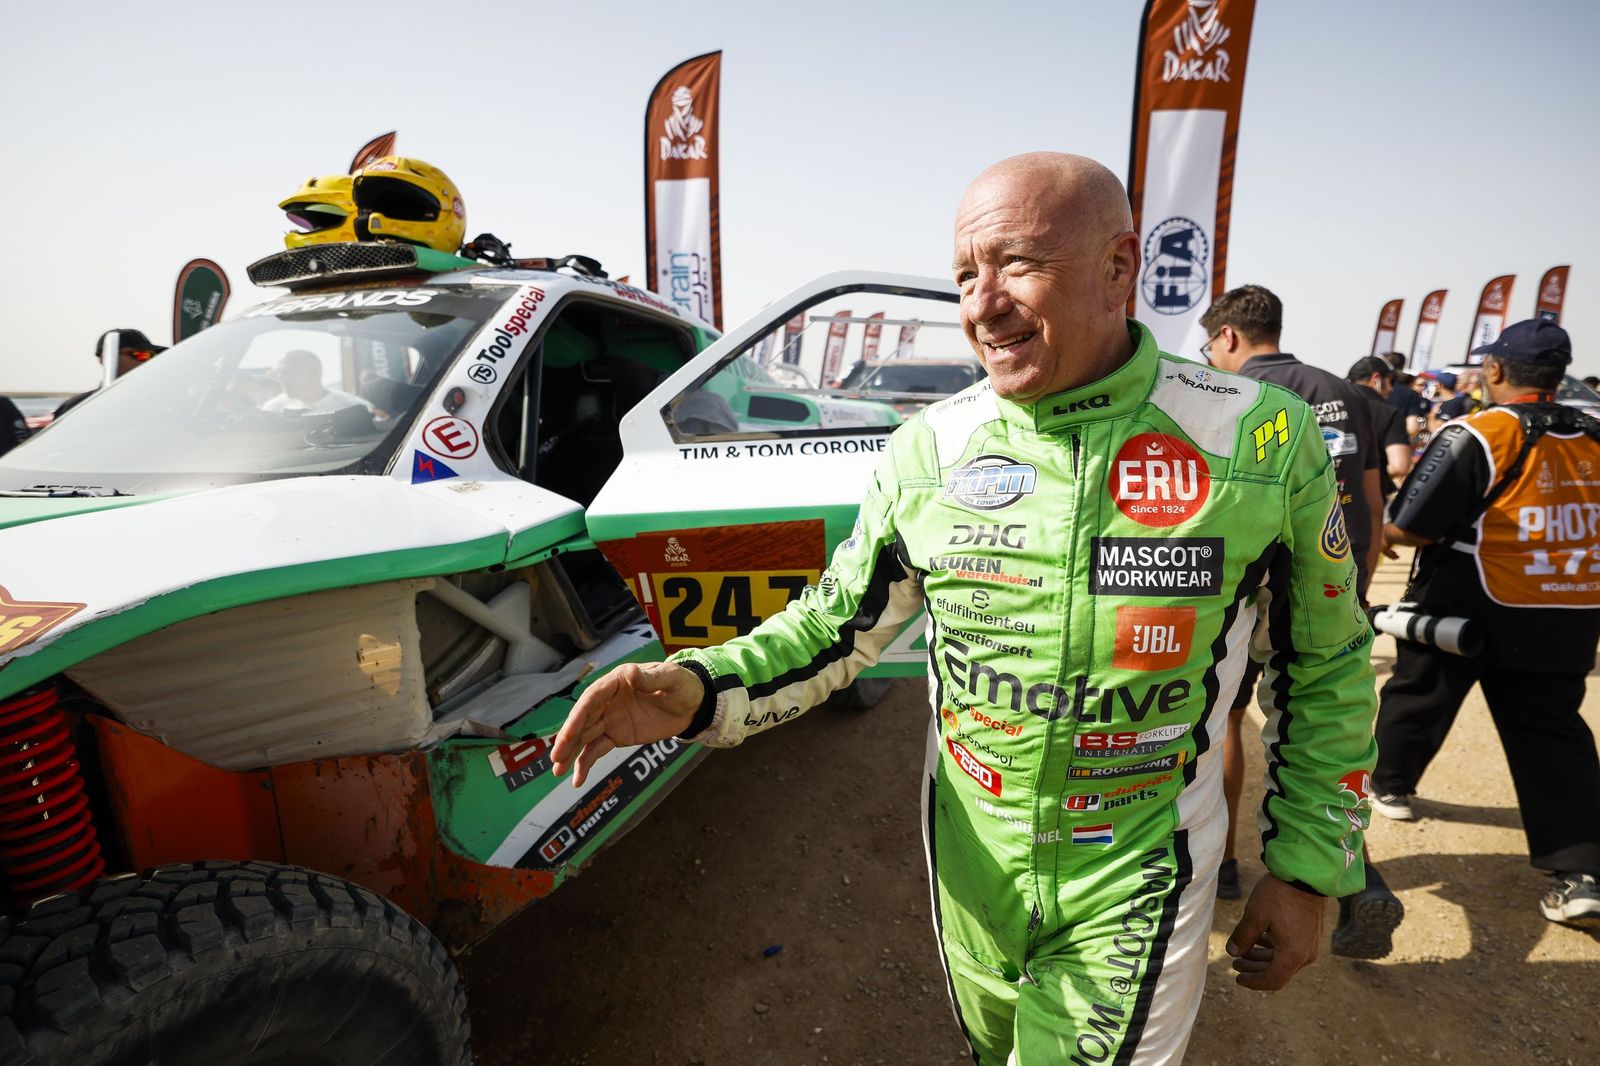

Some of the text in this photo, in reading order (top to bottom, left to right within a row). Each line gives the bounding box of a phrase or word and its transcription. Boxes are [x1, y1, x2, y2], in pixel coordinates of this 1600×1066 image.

[1162, 49, 1231, 82] DAKAR
[660, 134, 708, 161] DAKAR
[476, 285, 546, 364] Toolspecial
[1053, 394, 1112, 416] LKQ
[431, 421, 472, 453] E
[680, 438, 890, 460] TIM & TOM CORONE
[1249, 407, 1290, 465] P1
[1119, 459, 1199, 501] ERU
[1130, 505, 1187, 515] Since 1824
[949, 524, 1027, 549] DHG
[929, 557, 1001, 575] KEUKEN
[1100, 545, 1213, 568] MASCOT®
[956, 570, 1043, 587] warenhuis.nl
[1098, 569, 1212, 588] WORKWEAR
[663, 575, 808, 639] 247
[936, 597, 1036, 635] efulfilment.eu
[1132, 625, 1180, 654] JBL
[942, 636, 1191, 724] Emotive
[1077, 744, 1168, 757] INTERNATIO
[1080, 725, 1188, 750] BS FORKLIFTS
[1104, 788, 1159, 811] parts
[576, 794, 619, 838] parts
